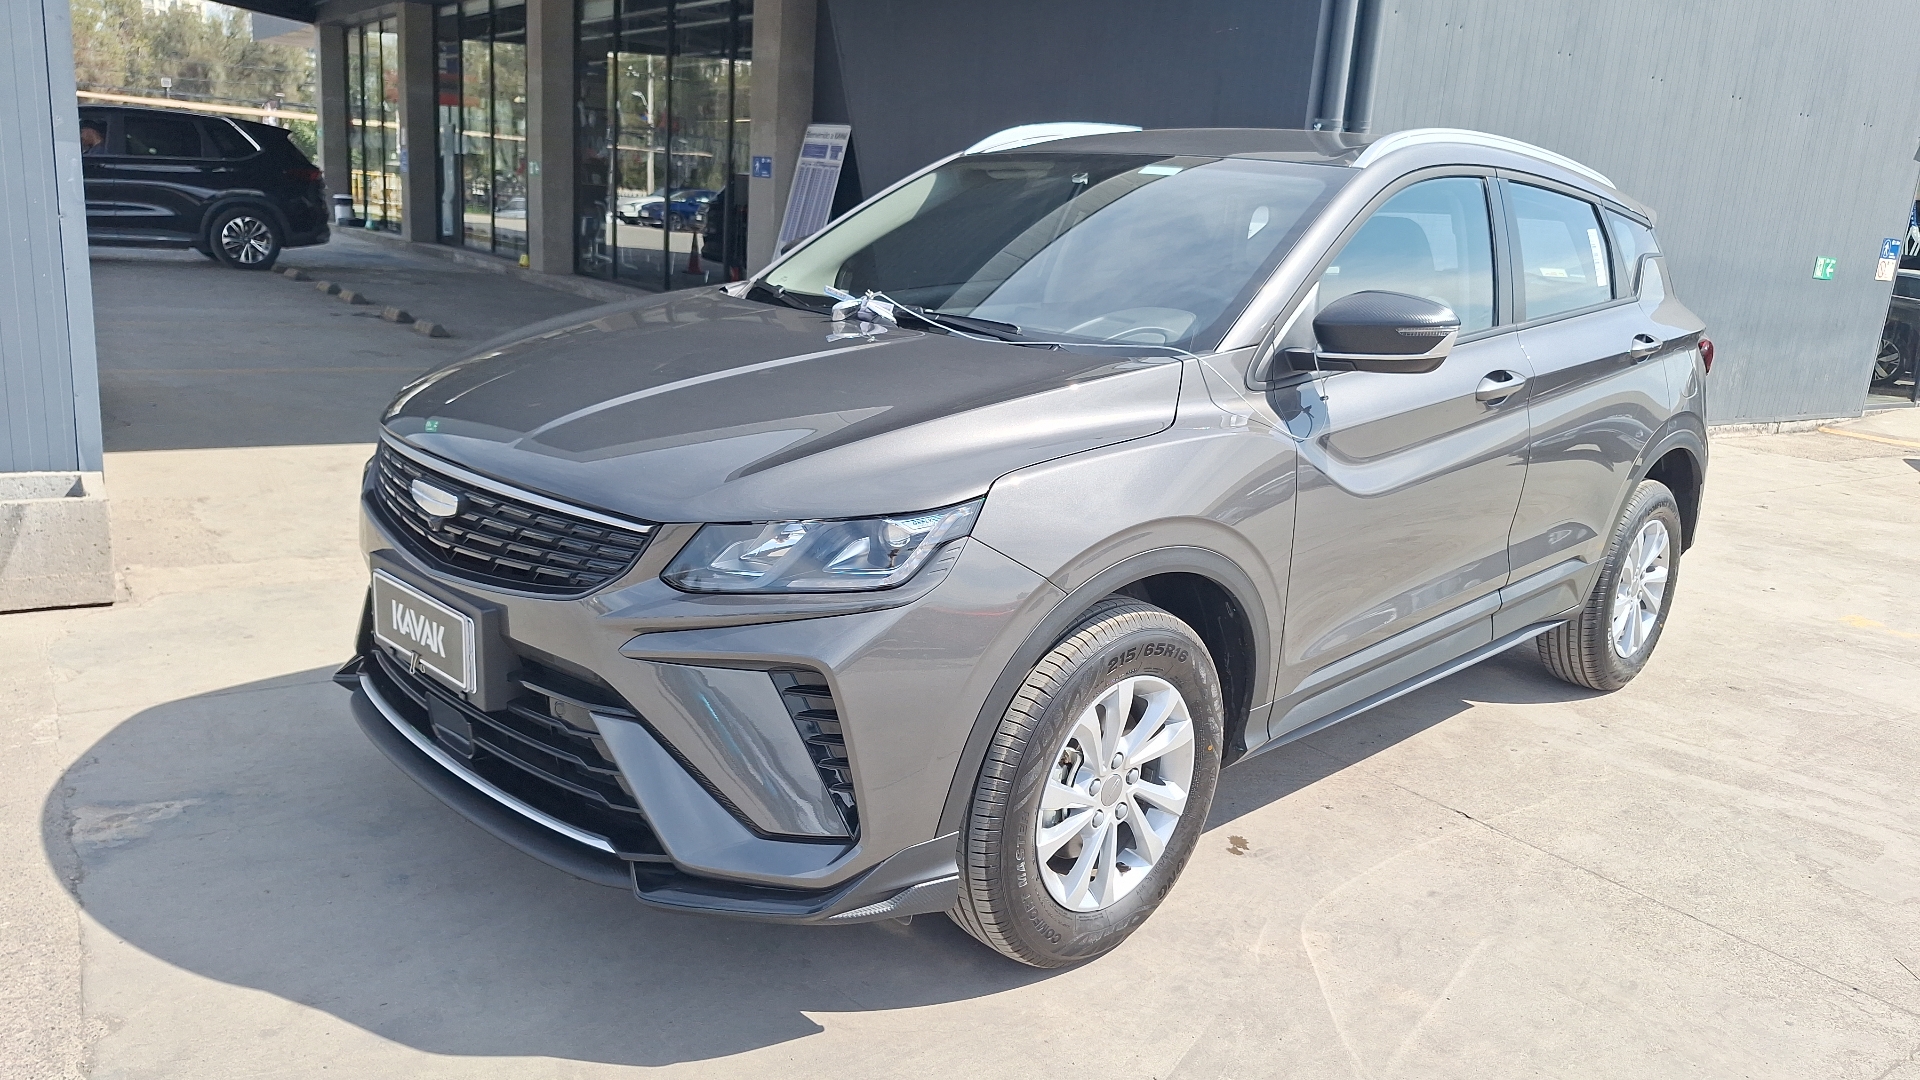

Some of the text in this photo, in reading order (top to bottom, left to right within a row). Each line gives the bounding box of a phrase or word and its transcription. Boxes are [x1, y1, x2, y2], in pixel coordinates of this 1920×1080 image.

[391, 599, 446, 658] KAVAK
[1107, 642, 1189, 675] 215/65R16
[1015, 810, 1030, 888] MASTER
[1022, 893, 1062, 945] COMFORT
